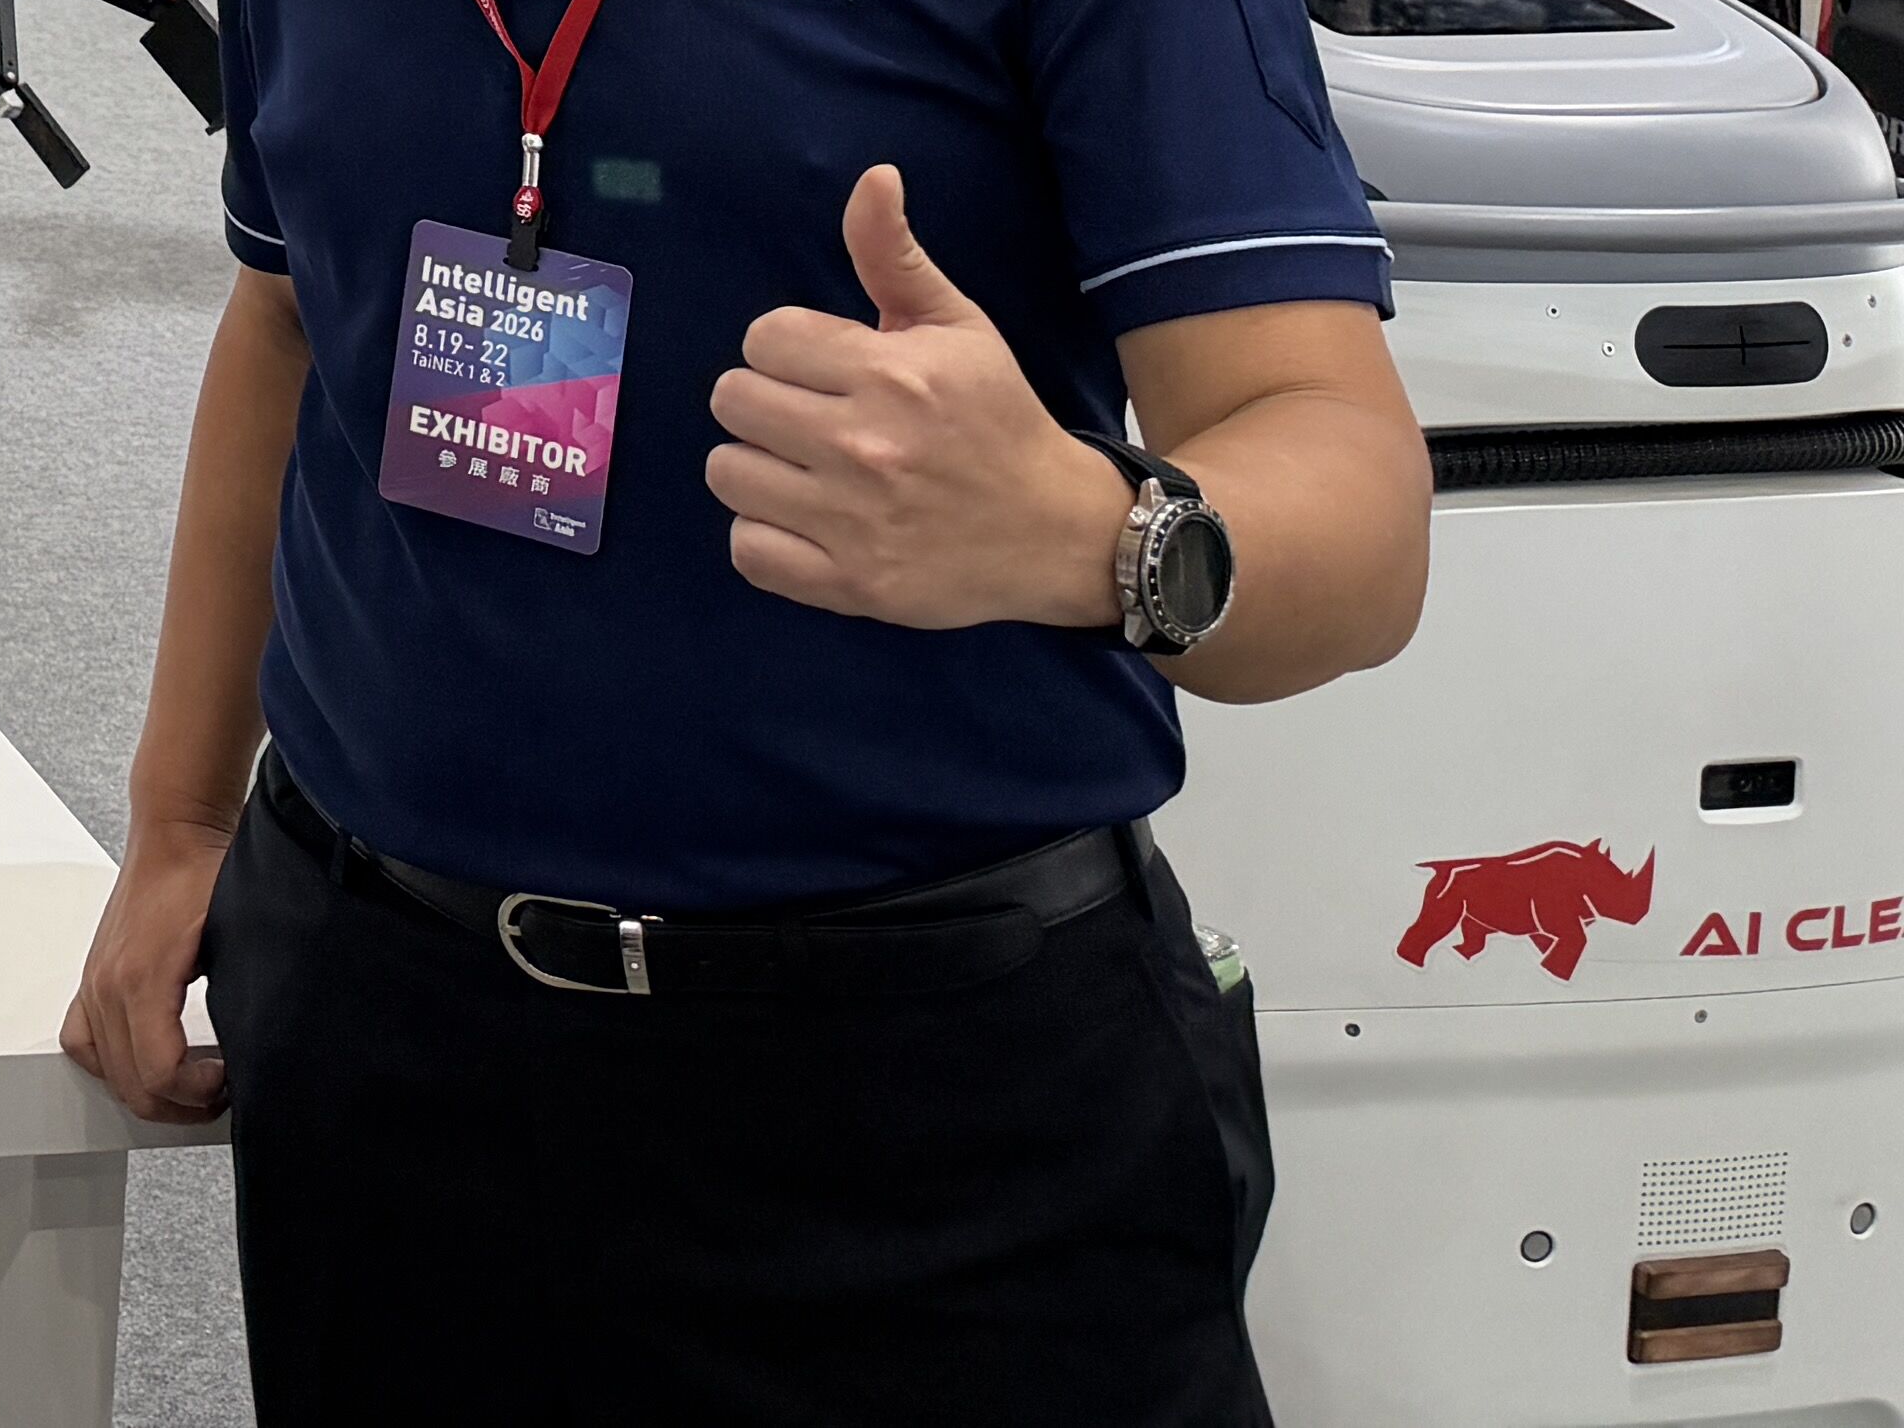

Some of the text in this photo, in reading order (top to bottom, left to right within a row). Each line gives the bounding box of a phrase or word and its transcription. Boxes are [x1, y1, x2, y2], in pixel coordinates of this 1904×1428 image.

[415, 287, 544, 342] Asia 2026
[422, 256, 589, 321] Intelligent
[411, 349, 505, 387] TaiNEX 1 & 2
[410, 405, 587, 477] EXHIBITOR
[438, 449, 550, 495] 參展廠商
[1679, 896, 1904, 956] AI CLE
